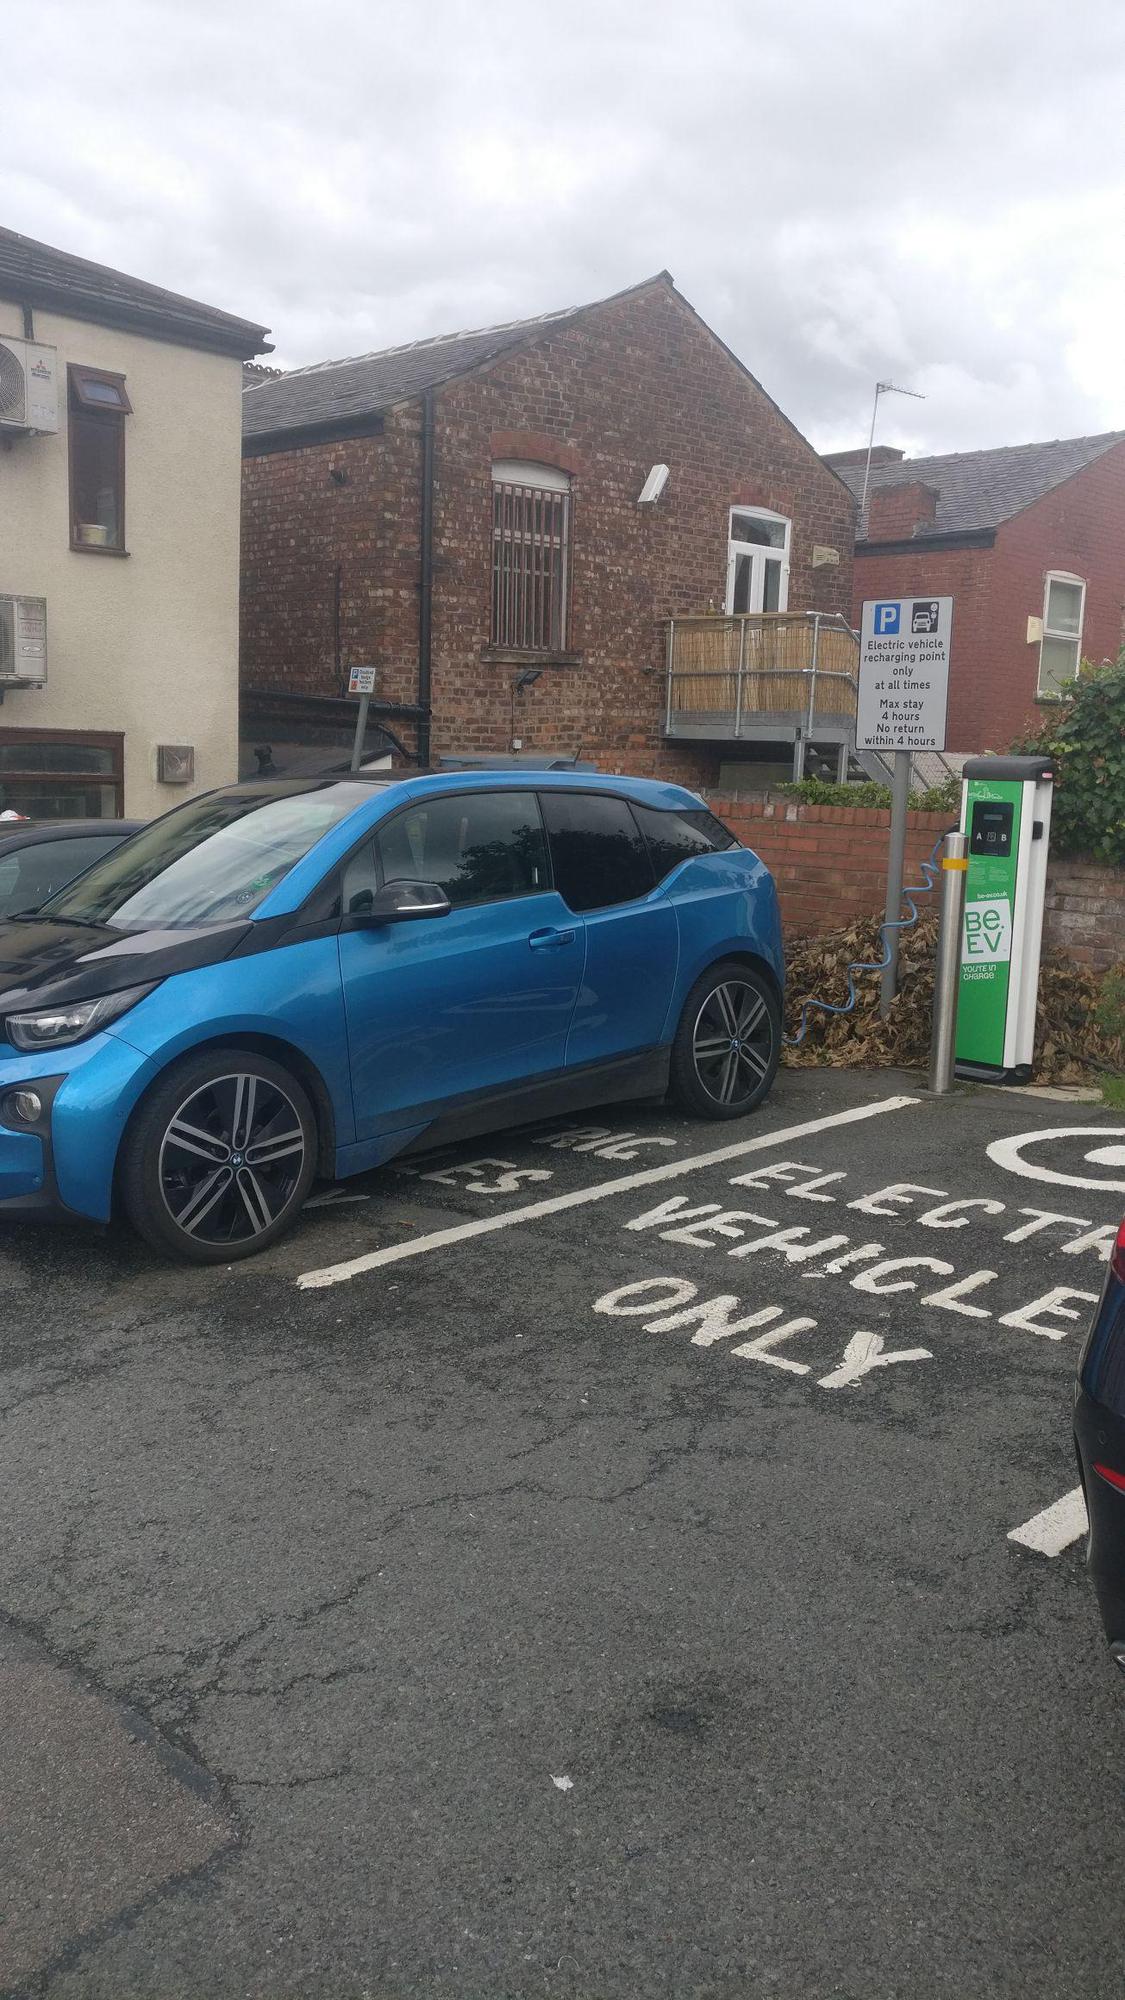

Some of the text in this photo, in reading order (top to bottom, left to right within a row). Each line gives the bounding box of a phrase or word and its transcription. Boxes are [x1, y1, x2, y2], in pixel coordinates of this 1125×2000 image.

[880, 607, 897, 632] P
[867, 639, 944, 650] Electric vehicle
[864, 651, 945, 663] recharging point
[892, 665, 914, 677] only
[875, 680, 931, 690] at all times
[879, 699, 924, 710] Max stay
[881, 711, 920, 721] 4 hours
[876, 723, 925, 733] No return
[864, 735, 936, 746] within 4 hours
[976, 832, 1007, 842] A B
[967, 931, 1002, 954] EV
[728, 1161, 1119, 1262] ELECTR
[622, 1195, 1101, 1341] VEHICLE
[592, 1276, 934, 1389] ONLY
